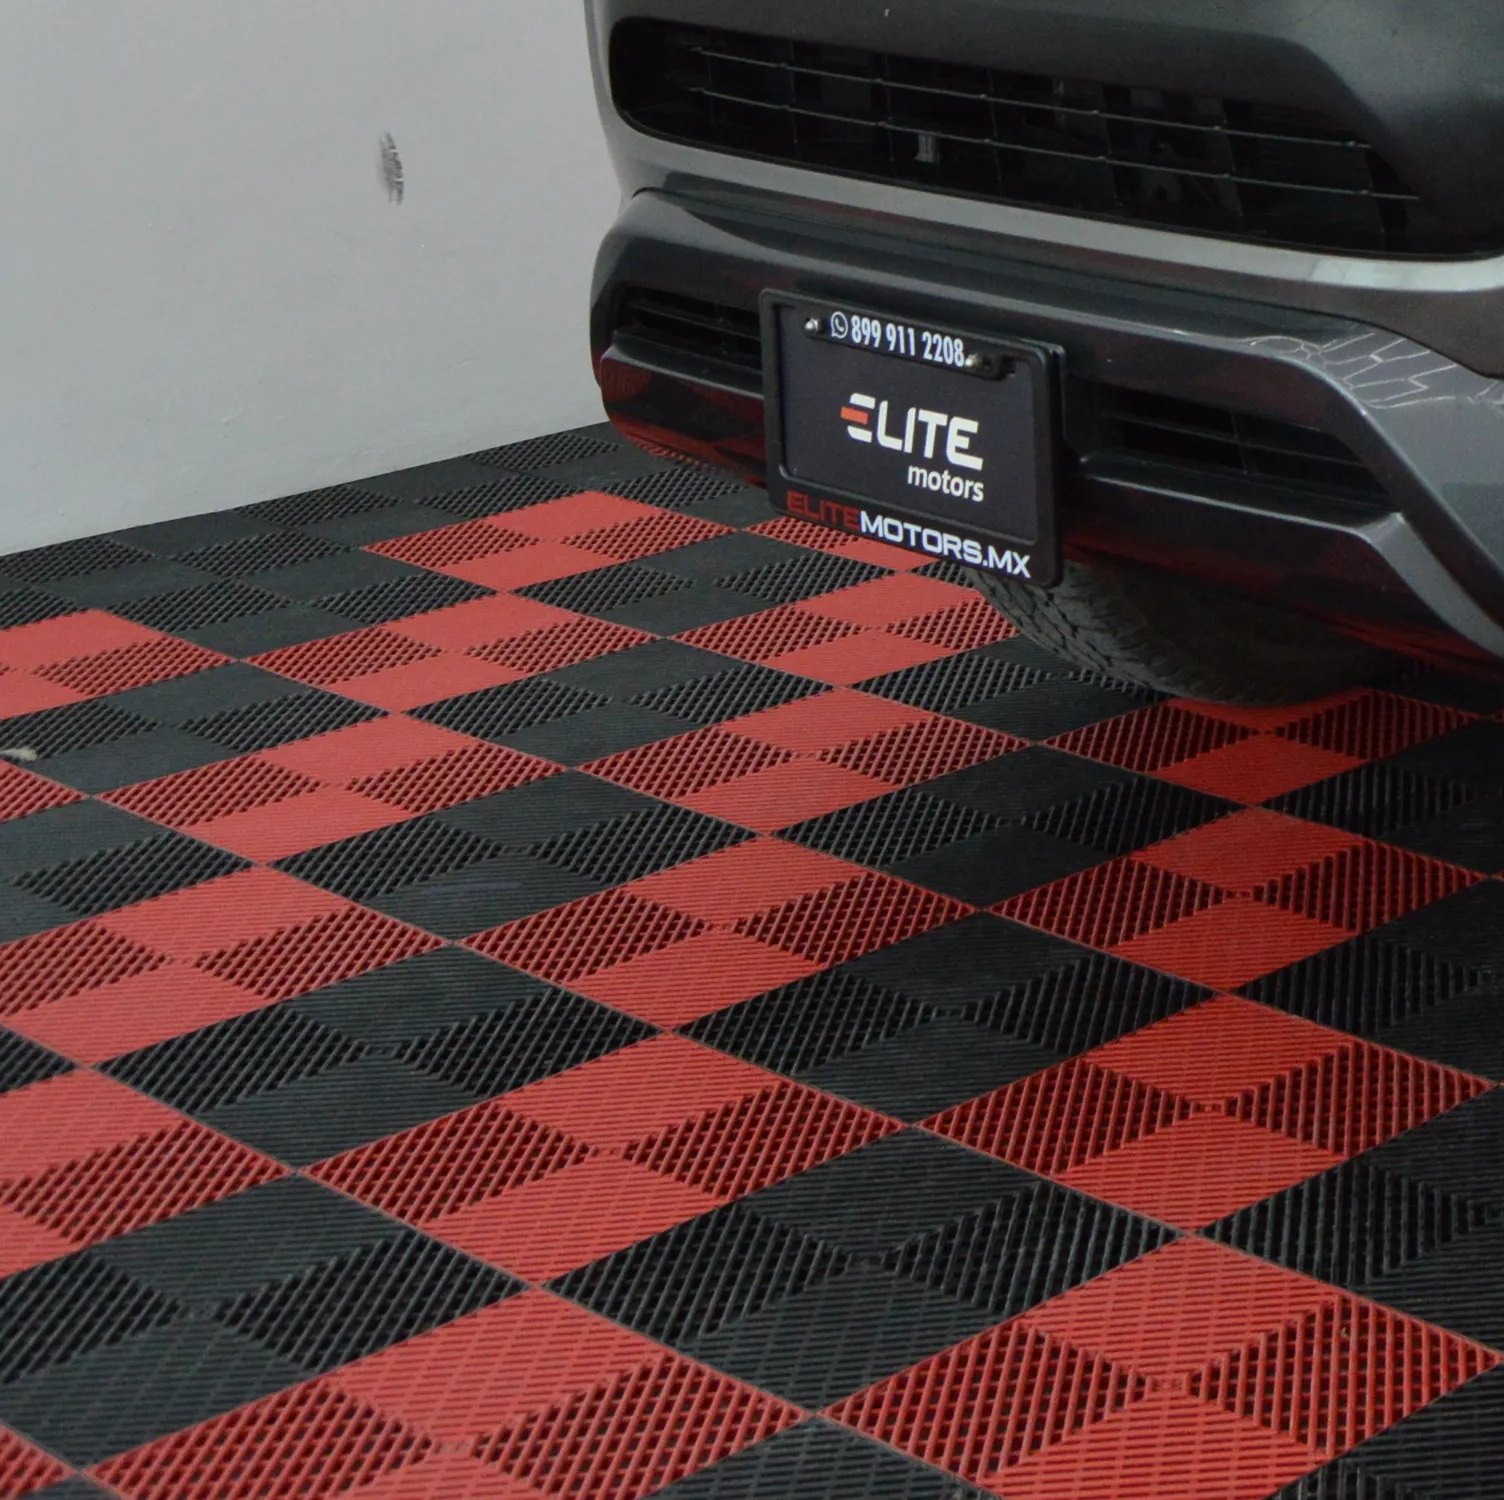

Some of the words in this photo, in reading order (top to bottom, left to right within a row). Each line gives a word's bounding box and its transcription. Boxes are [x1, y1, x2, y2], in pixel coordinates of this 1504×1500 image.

[850, 314, 882, 348] 899
[885, 322, 916, 357] 911
[921, 330, 966, 368] 2208
[840, 392, 984, 471] ELITE
[907, 464, 985, 503] motors
